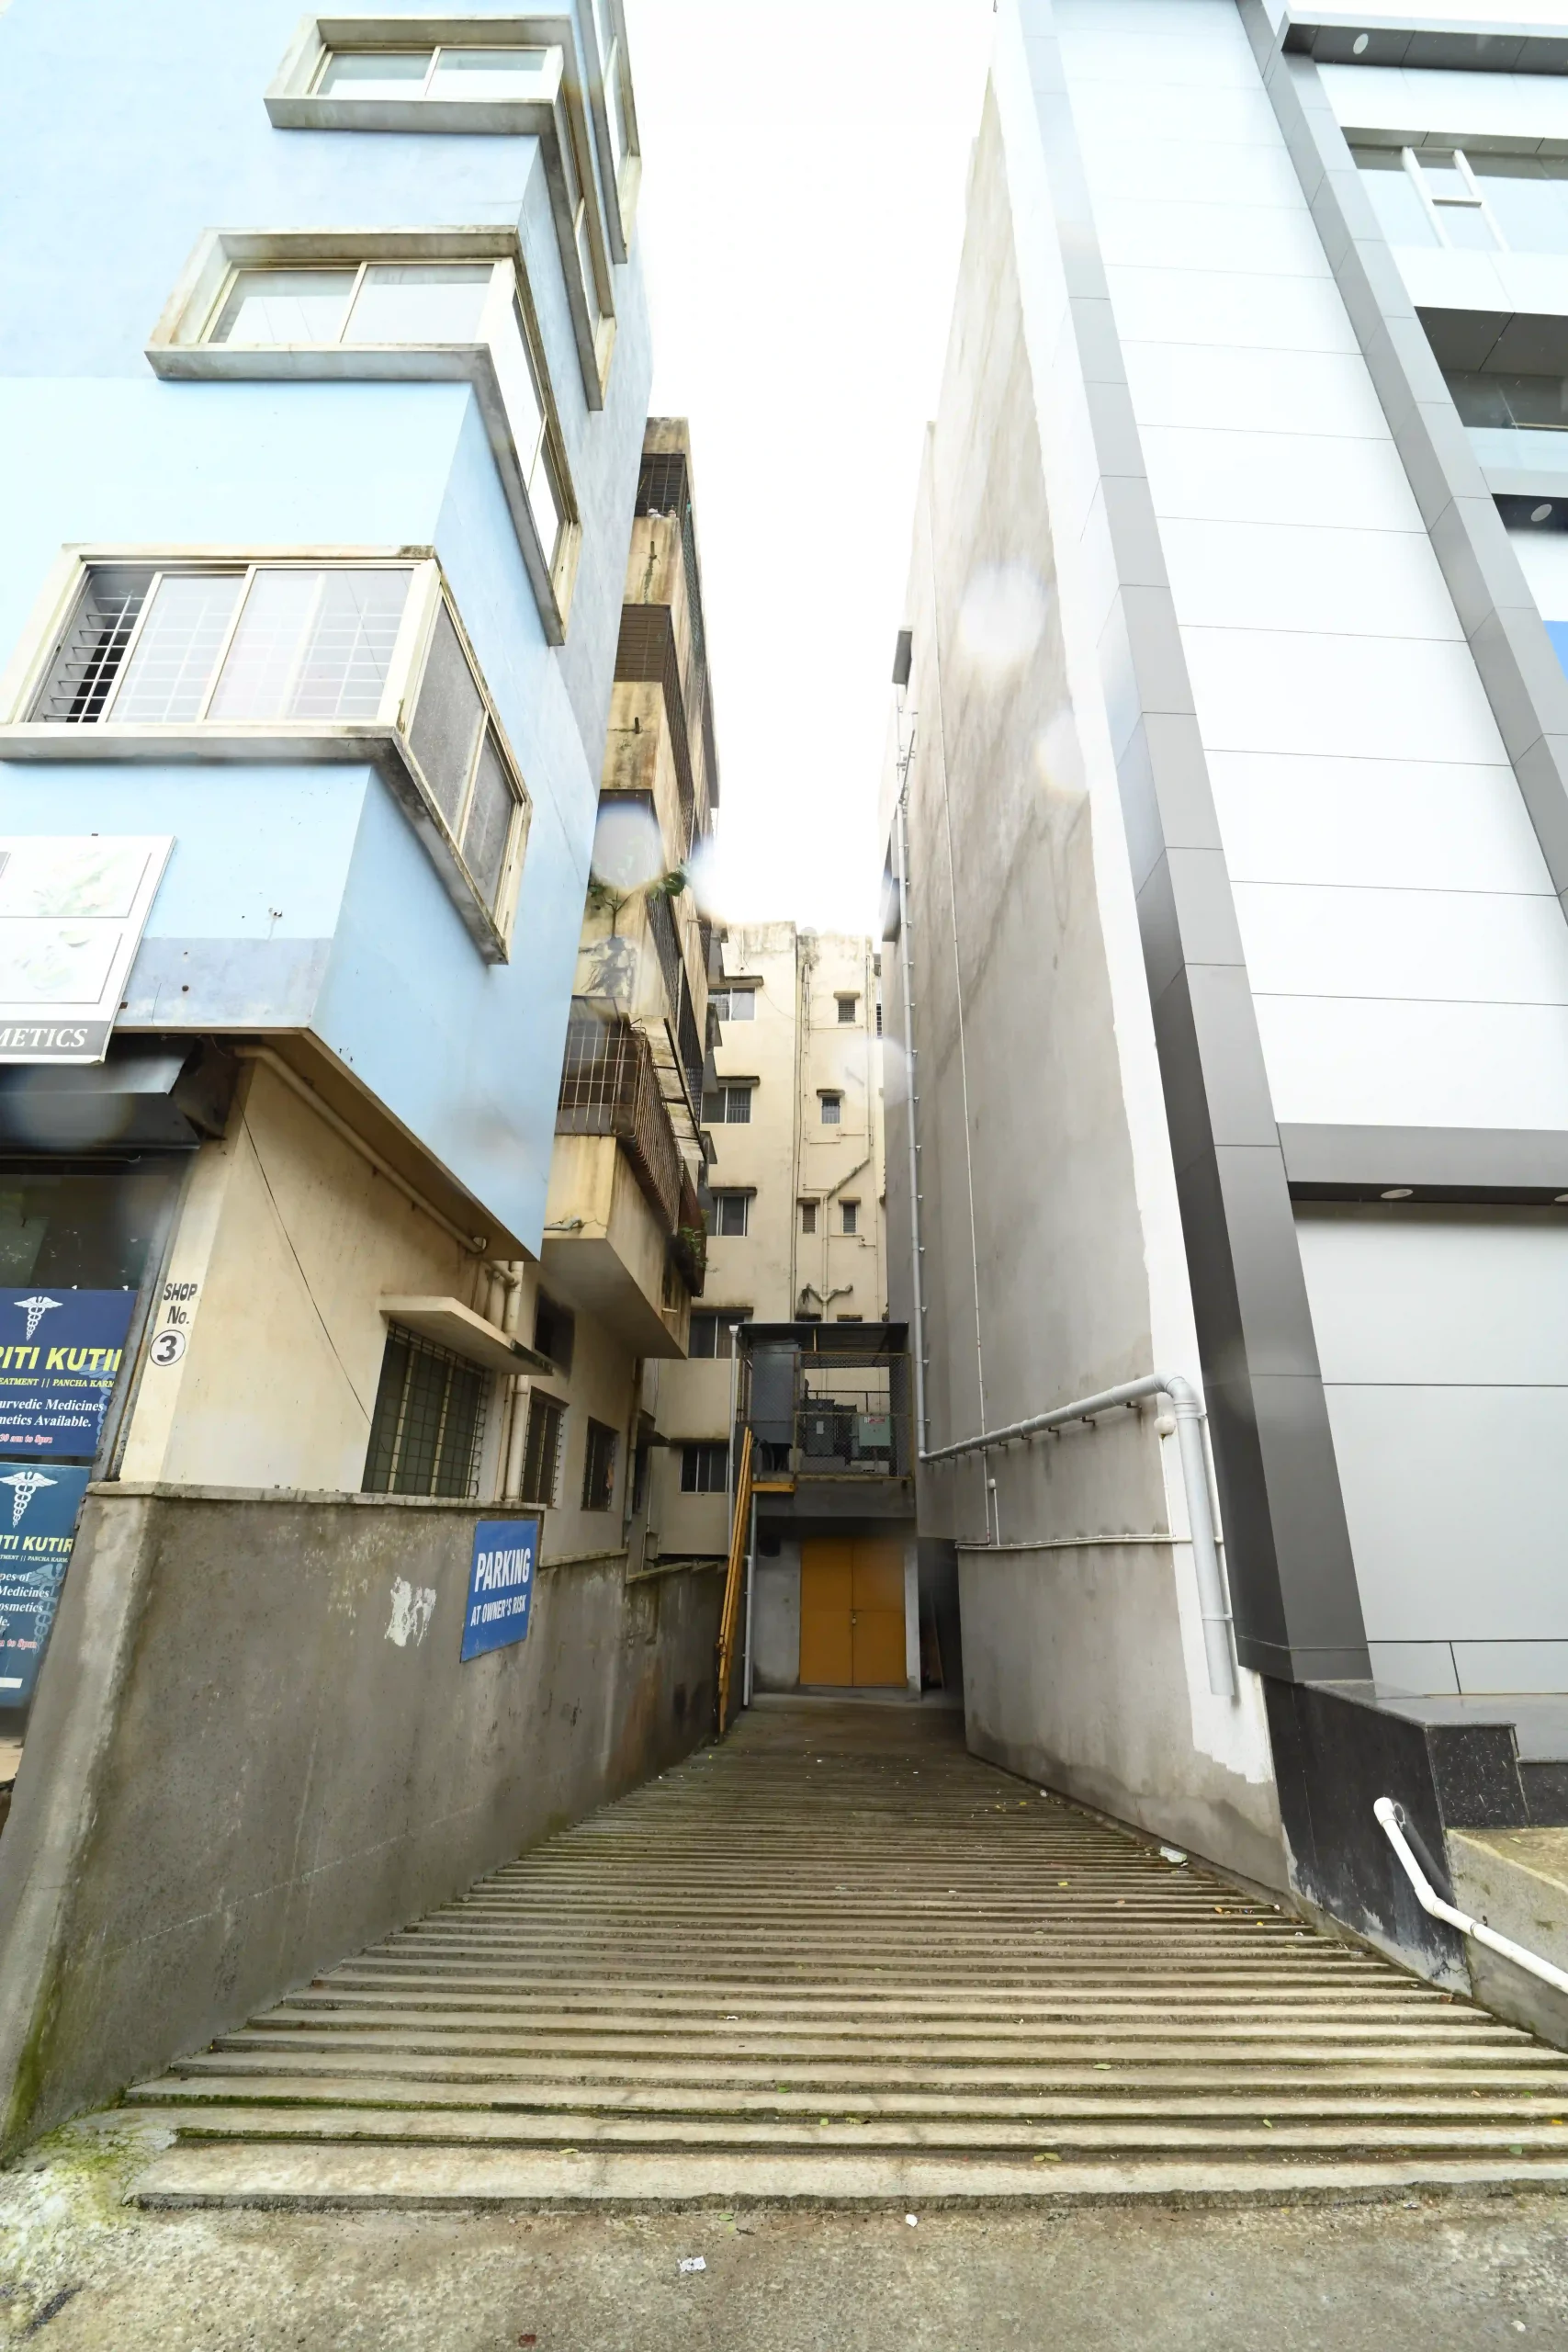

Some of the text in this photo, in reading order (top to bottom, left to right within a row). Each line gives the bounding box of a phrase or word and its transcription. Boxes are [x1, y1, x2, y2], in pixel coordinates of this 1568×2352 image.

[163, 1283, 198, 1301] SHOP
[166, 1306, 190, 1325] No.
[156, 1335, 177, 1363] 3
[52, 1378, 88, 1387] PANCHA
[44, 1398, 105, 1412] Medicines
[33, 1415, 92, 1428] Available.
[18, 1571, 32, 1582] of
[474, 1547, 531, 1592] PARKING
[470, 1594, 526, 1626] AT OWNER'S RISK
